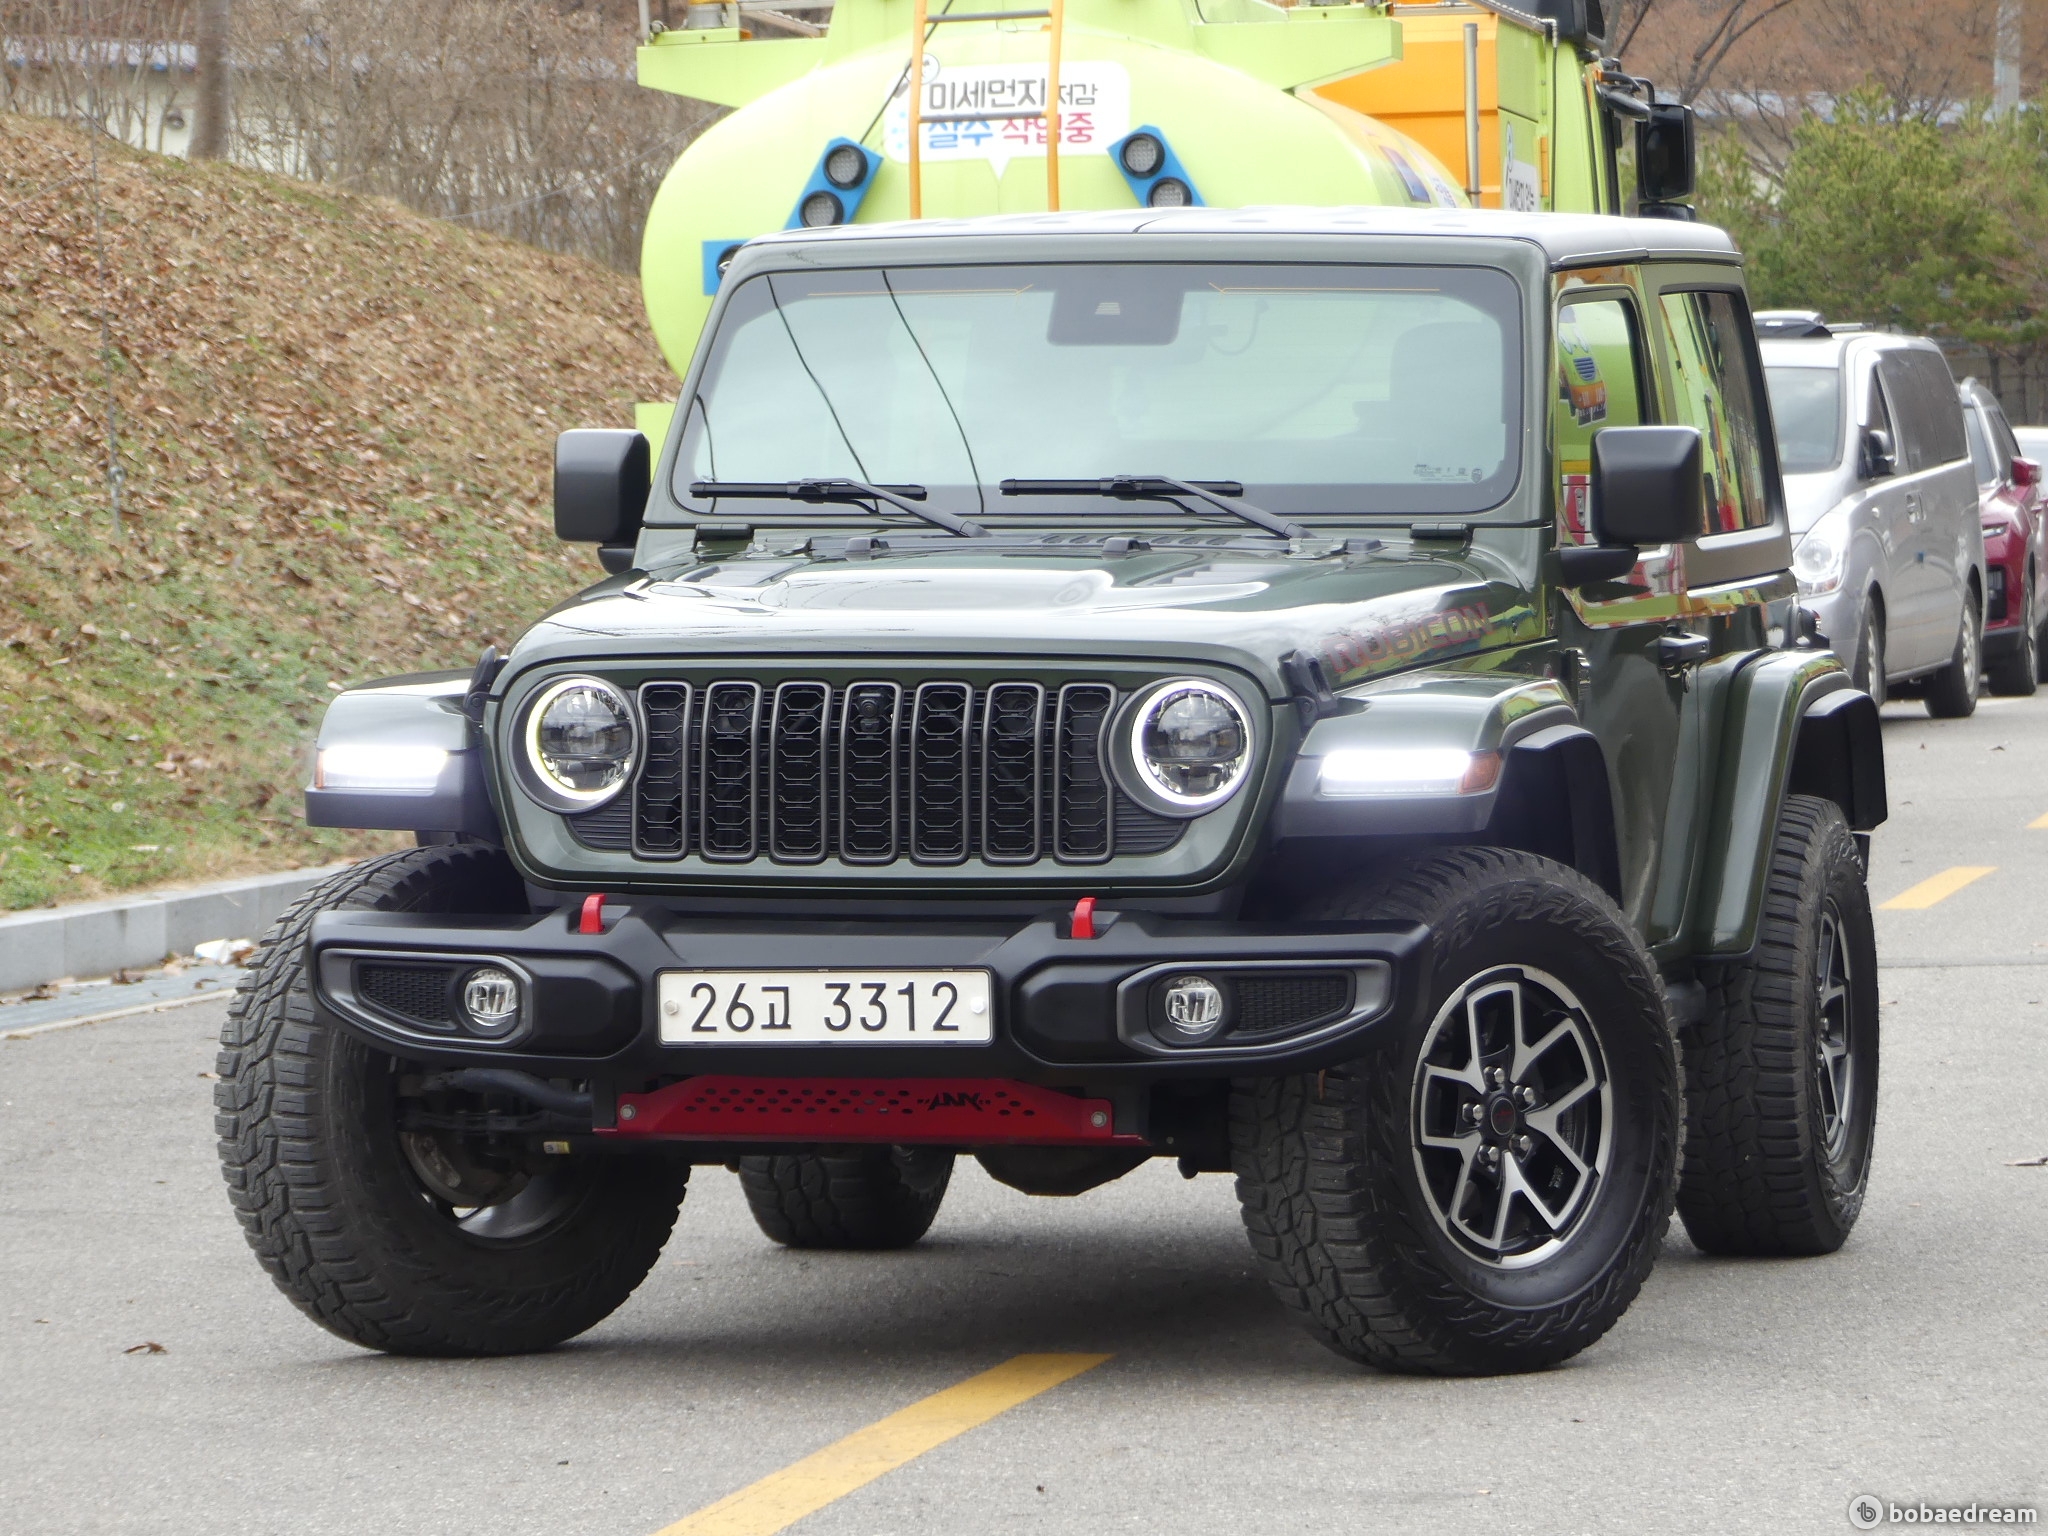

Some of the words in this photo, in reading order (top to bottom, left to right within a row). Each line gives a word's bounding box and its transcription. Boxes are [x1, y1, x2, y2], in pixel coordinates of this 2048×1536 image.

[929, 78, 1046, 110] 미세먼지
[1057, 83, 1098, 105] 저감
[1321, 602, 1495, 673] RUBICON
[690, 982, 791, 1033] 26고
[823, 981, 960, 1032] 3312
